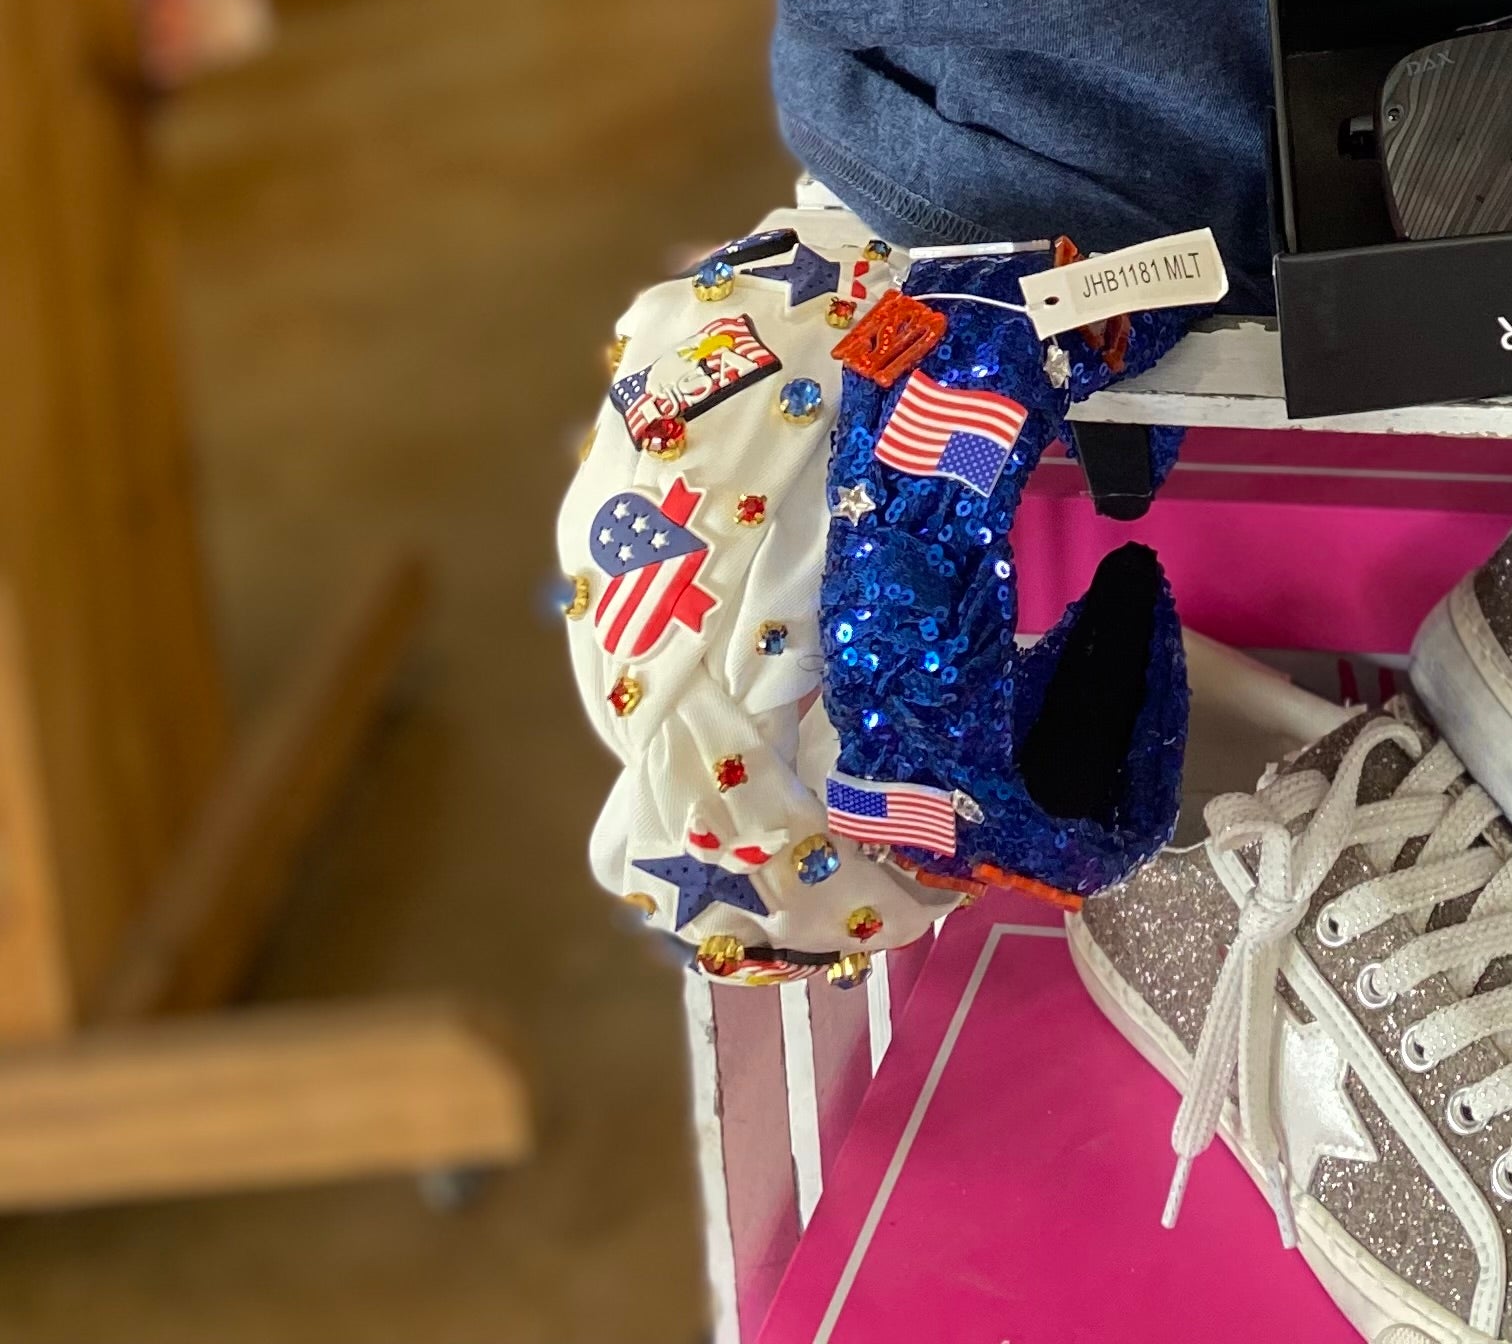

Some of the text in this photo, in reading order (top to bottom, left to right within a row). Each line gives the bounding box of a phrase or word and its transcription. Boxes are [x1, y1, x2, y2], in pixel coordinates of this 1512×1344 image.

[1082, 252, 1202, 298] JHB1181 MLT
[637, 346, 761, 425] USA
